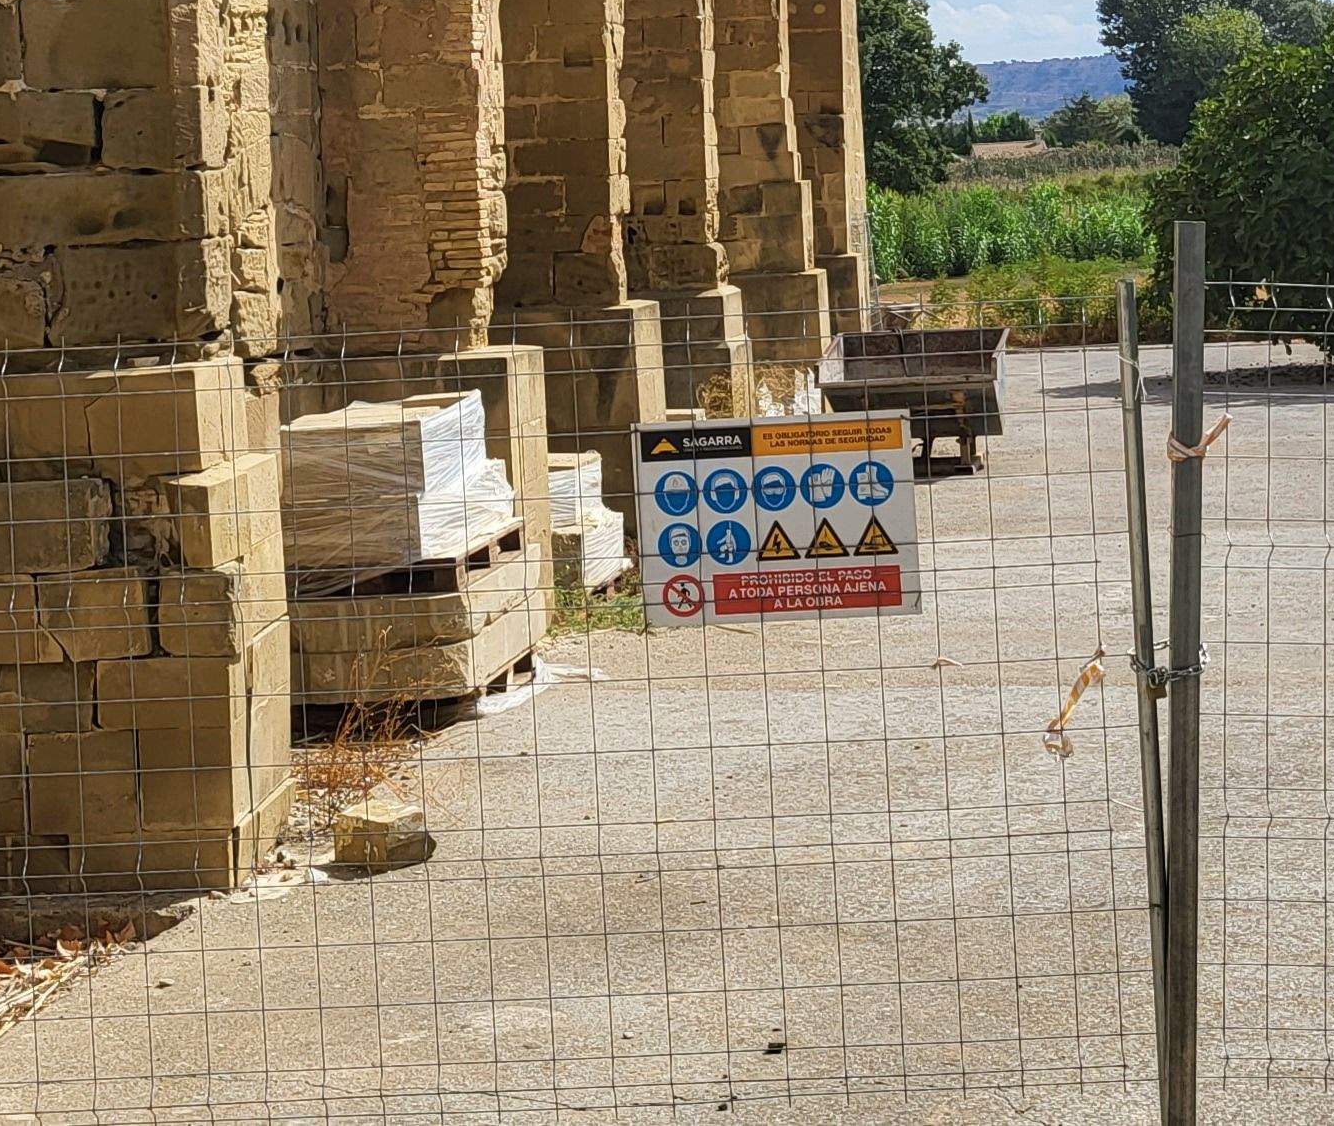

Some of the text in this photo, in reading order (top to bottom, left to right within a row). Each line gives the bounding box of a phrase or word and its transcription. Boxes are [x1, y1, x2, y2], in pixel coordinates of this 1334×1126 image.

[762, 426, 892, 440] ES OBLIGATORIO SEGUIR TODAS
[682, 435, 743, 448] SAGARRA
[769, 435, 886, 448] LAS NORMAS DE SEGURIDAD
[740, 569, 872, 586] PROHIBIDO EL PASO
[728, 581, 887, 599] A TODA PERSONA AJENA
[774, 596, 843, 609] A LA OBRA
